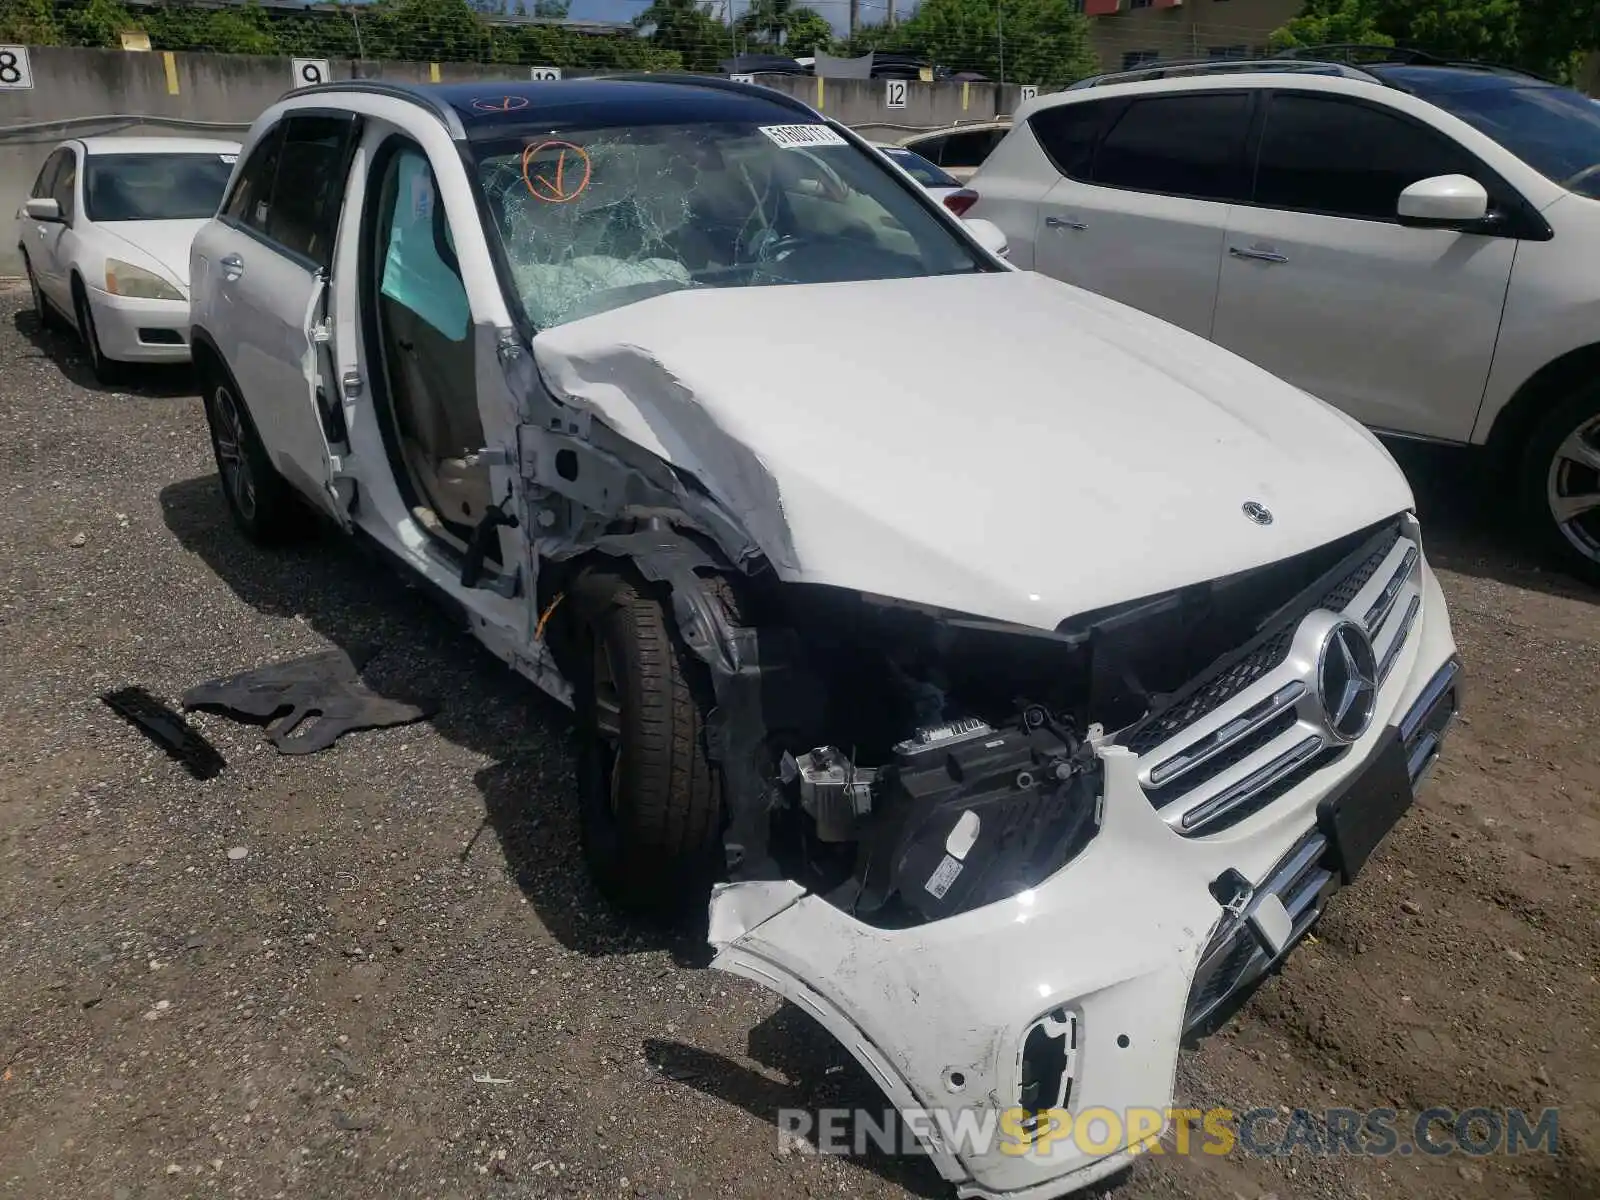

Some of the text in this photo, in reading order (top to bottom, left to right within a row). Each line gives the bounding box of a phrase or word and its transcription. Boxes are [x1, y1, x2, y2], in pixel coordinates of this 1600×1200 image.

[0, 51, 21, 83] 8
[302, 64, 321, 84] 9
[889, 83, 904, 105] 12
